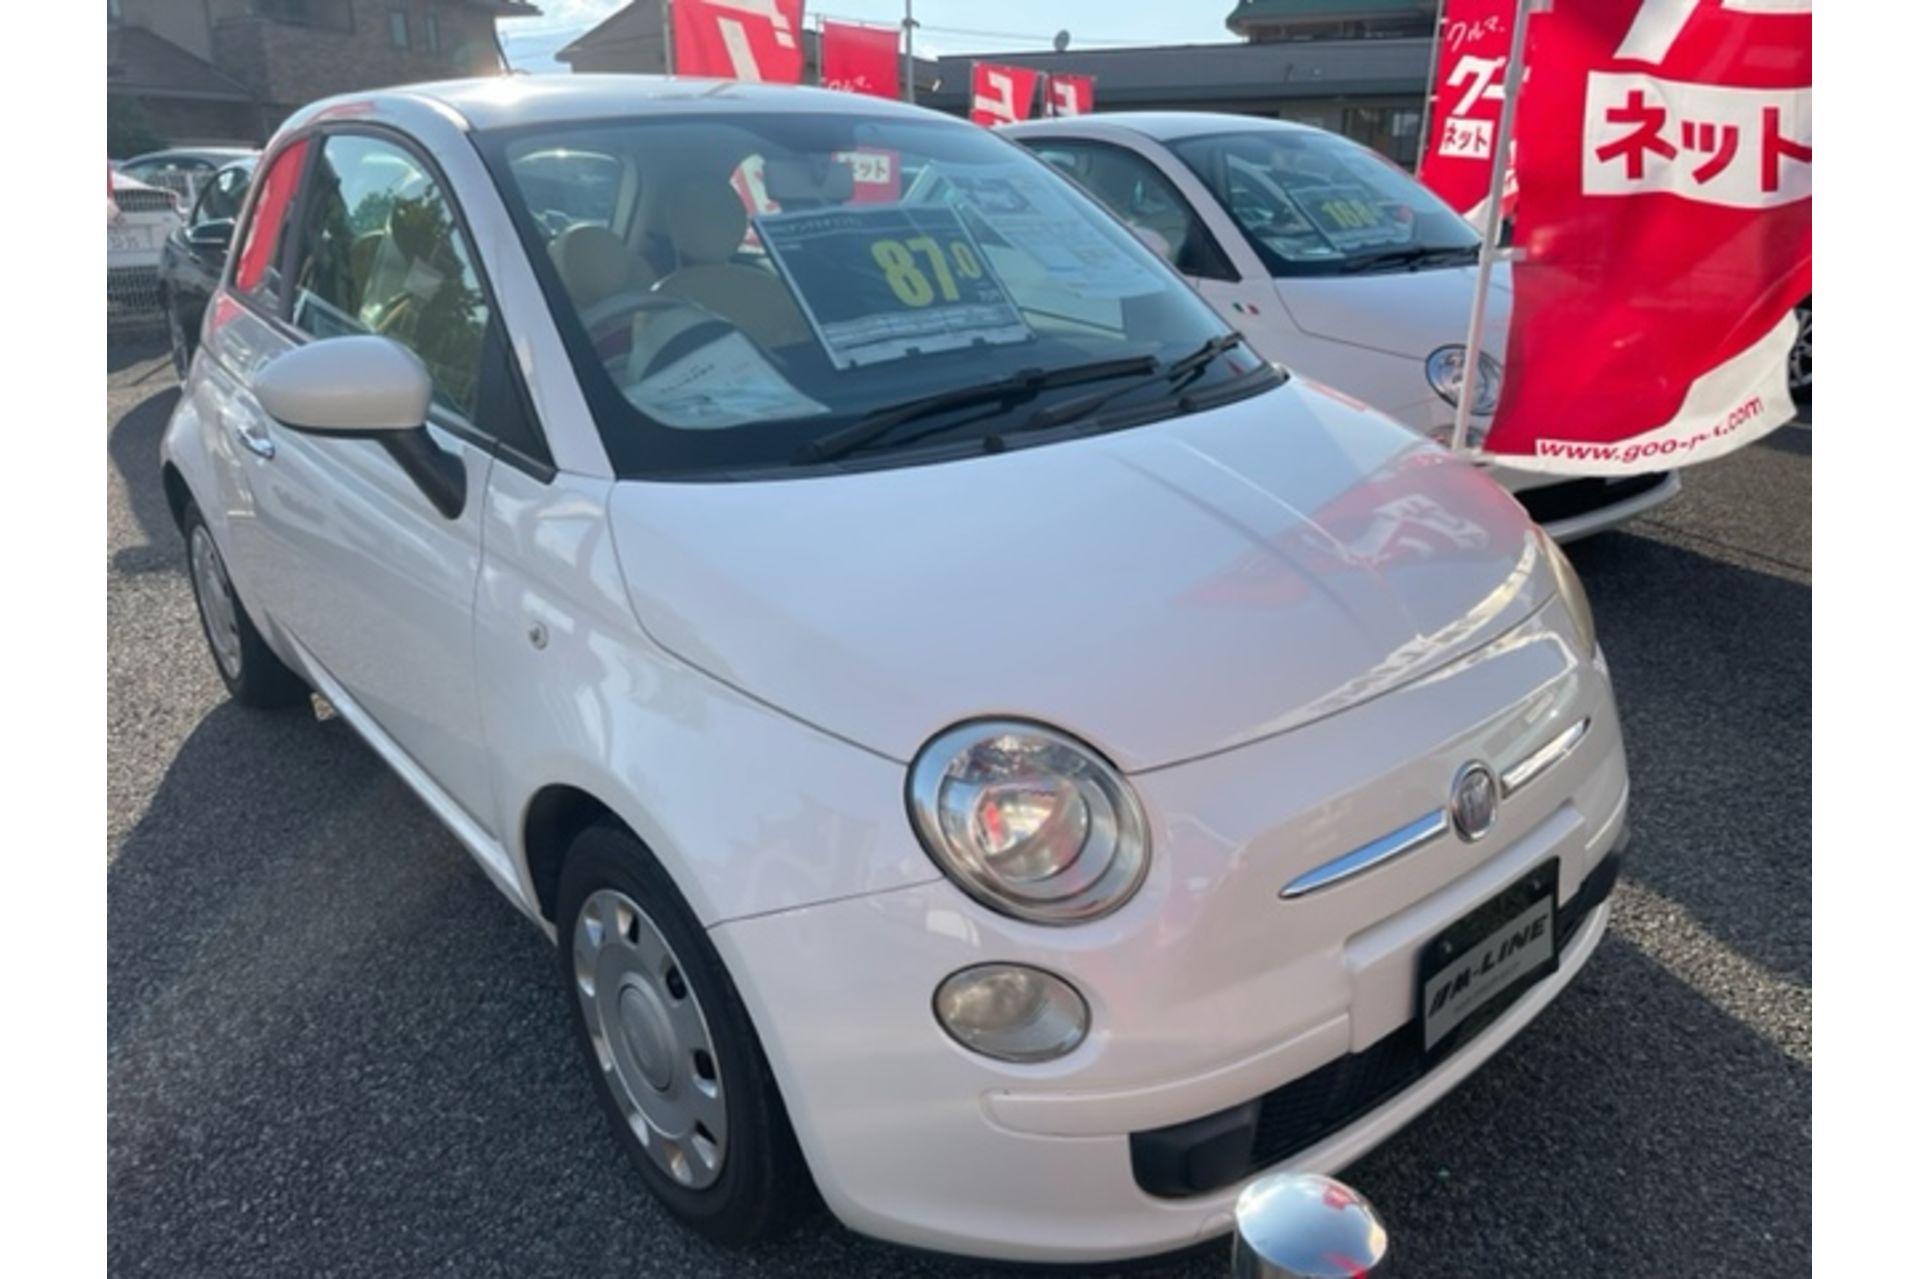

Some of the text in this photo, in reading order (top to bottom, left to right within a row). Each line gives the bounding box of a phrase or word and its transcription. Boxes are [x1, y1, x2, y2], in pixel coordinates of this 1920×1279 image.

[1444, 123, 1488, 152] ネット
[1595, 90, 1812, 192] ネット
[1538, 396, 1764, 463] www.goo-.com
